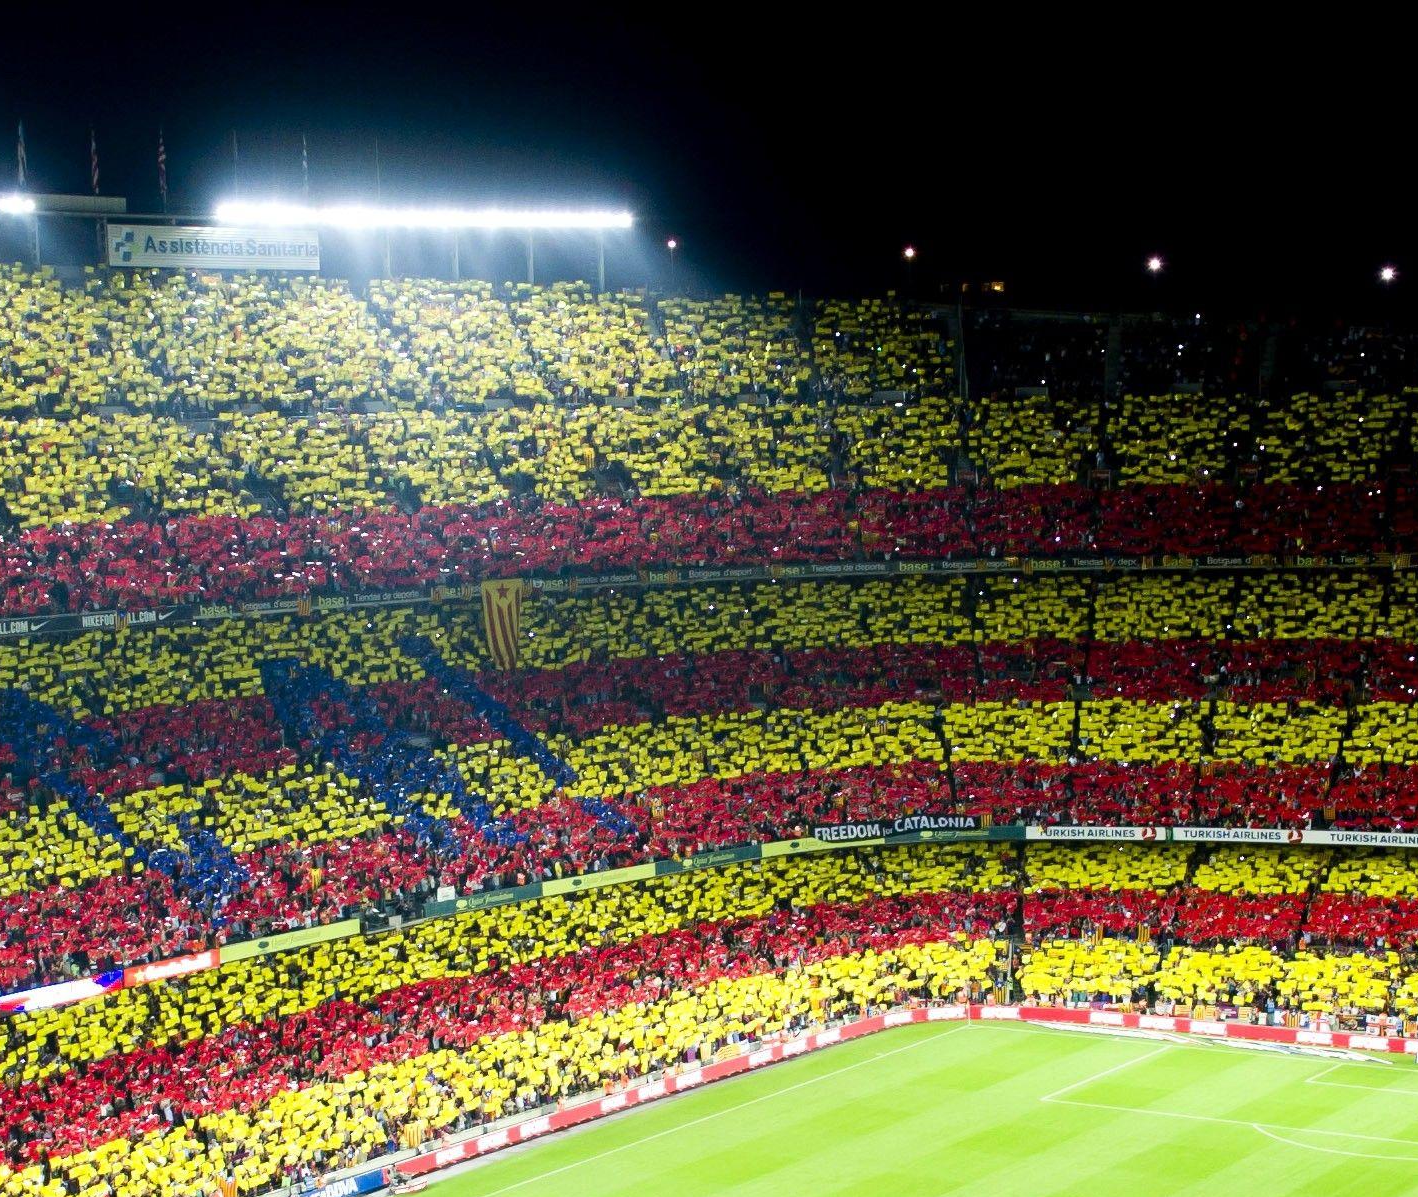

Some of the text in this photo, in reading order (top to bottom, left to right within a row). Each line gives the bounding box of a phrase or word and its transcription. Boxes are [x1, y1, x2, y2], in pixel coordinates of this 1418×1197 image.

[813, 823, 881, 842] FREEDOM
[894, 815, 976, 833] CATALONIA
[1087, 828, 1136, 839] AIRLINES
[1183, 829, 1282, 841] TURKISH AIRLINES
[1330, 832, 1378, 843] TURKISH
